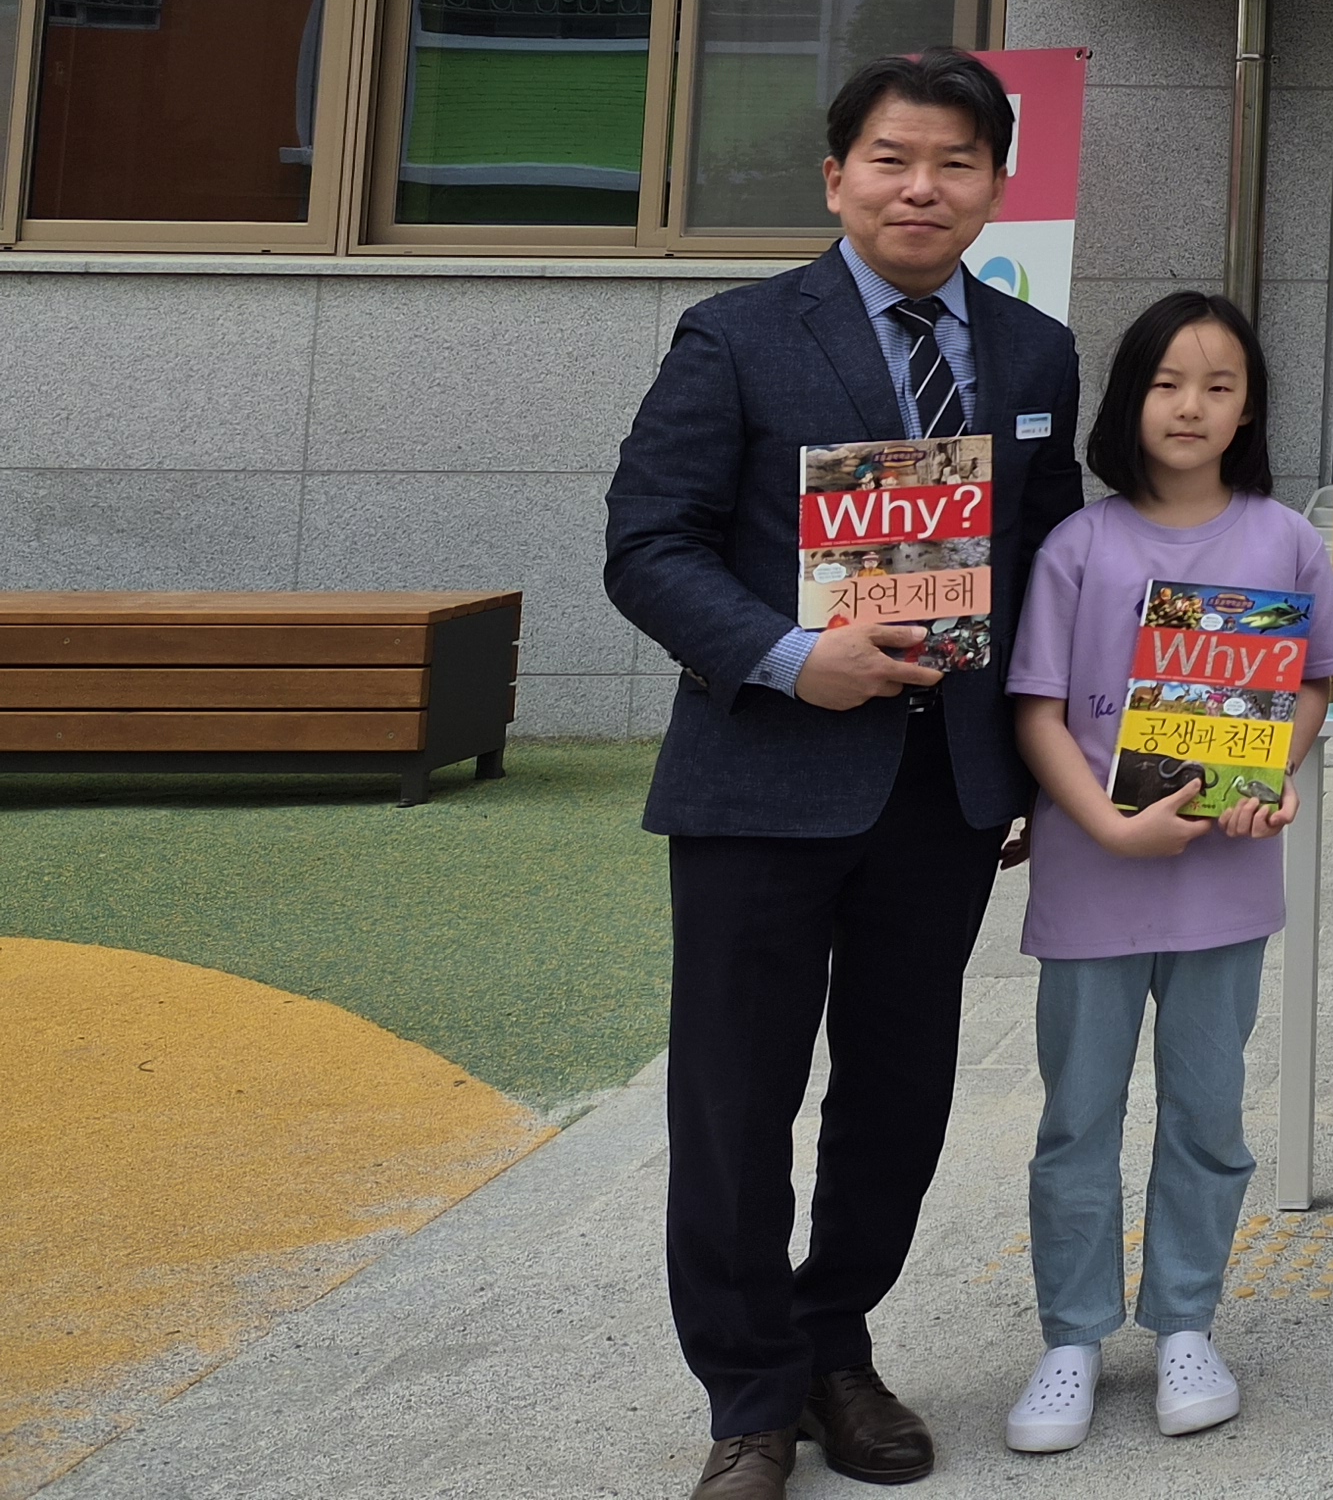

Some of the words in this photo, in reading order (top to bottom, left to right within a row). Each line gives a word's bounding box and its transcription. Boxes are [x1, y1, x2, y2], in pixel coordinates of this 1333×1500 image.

[817, 485, 983, 540] Why?
[827, 571, 975, 619] 자연재해
[1153, 630, 1299, 686] Why?
[1088, 694, 1116, 719] The
[1139, 718, 1217, 756] 공생과
[1220, 723, 1275, 762] 천적
